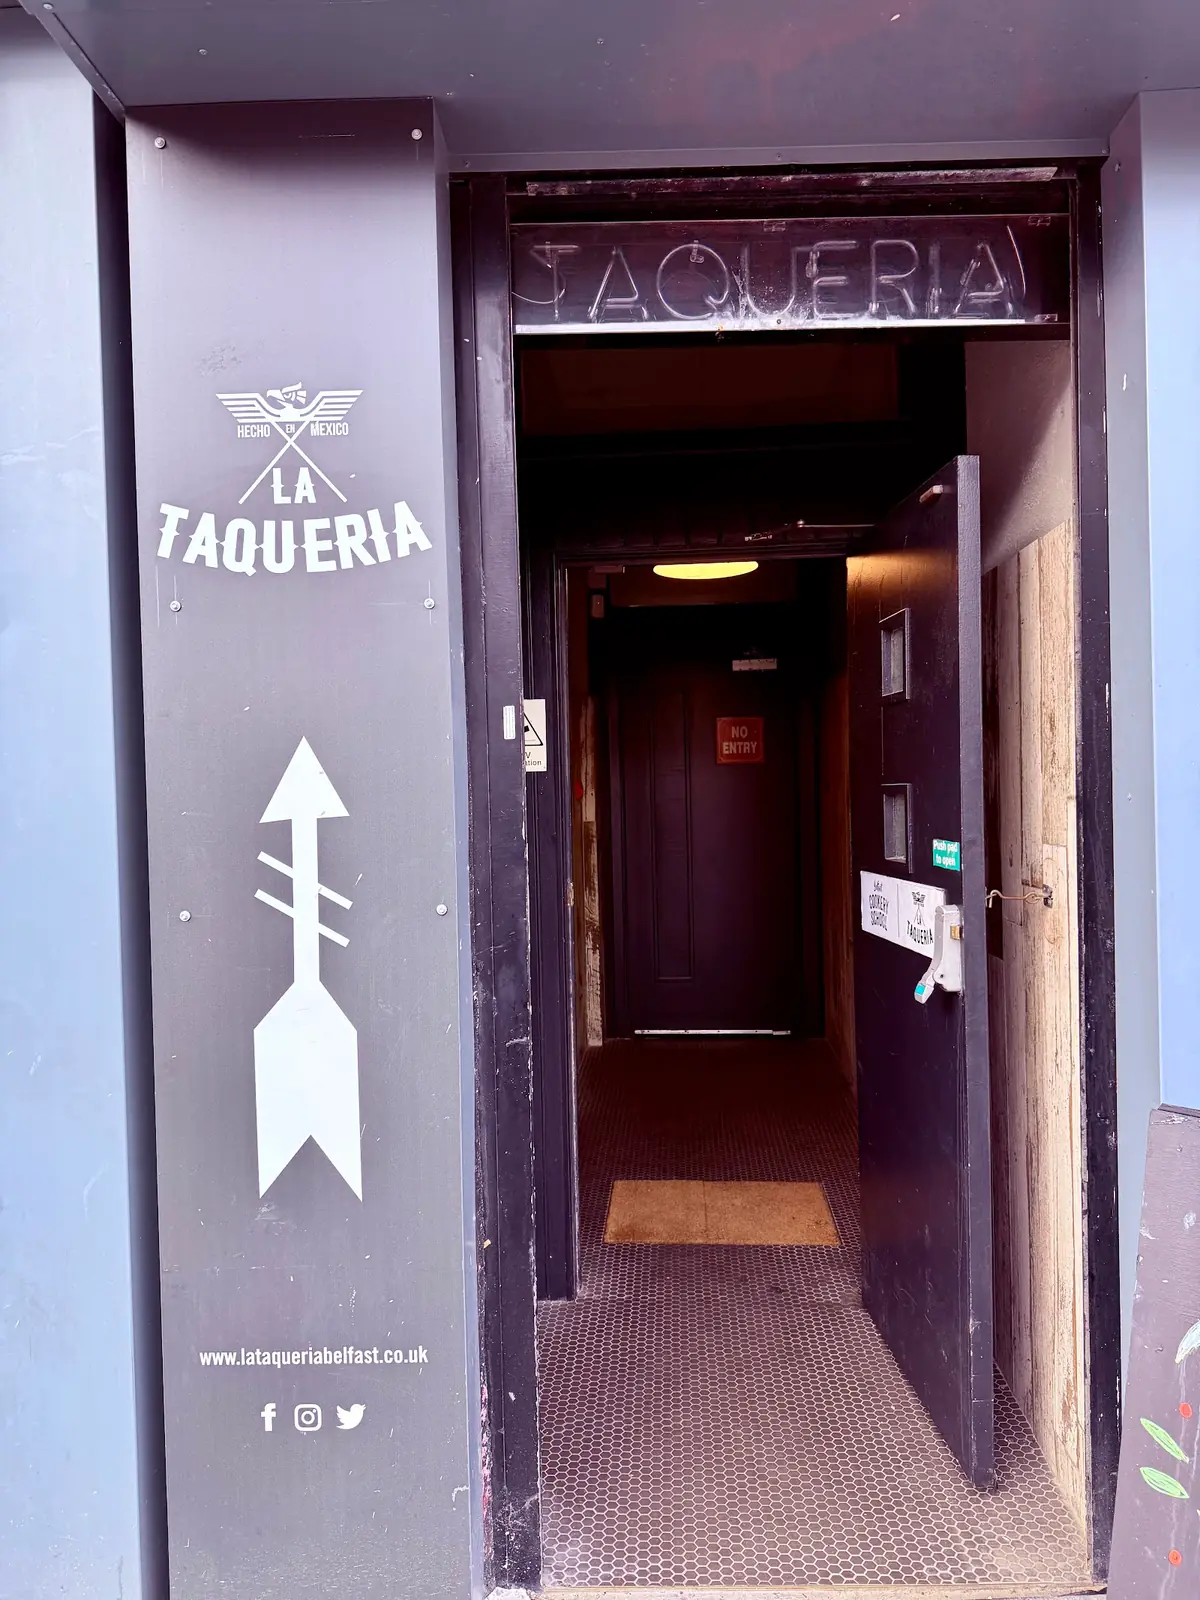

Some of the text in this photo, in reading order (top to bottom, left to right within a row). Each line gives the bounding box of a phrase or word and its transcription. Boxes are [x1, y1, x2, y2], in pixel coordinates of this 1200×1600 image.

[528, 239, 1015, 321] TAQUERIA
[237, 422, 349, 438] HECHO EN MEXICO
[271, 466, 317, 504] LA
[157, 500, 433, 577] TAQUERIA
[731, 726, 748, 739] NO
[722, 741, 757, 754] ENTRY
[933, 839, 957, 854] Push pad
[936, 853, 956, 868] to open
[907, 920, 934, 945] TAQUERIA
[199, 1346, 429, 1368] www.lataqueriabelfast.co.uk
